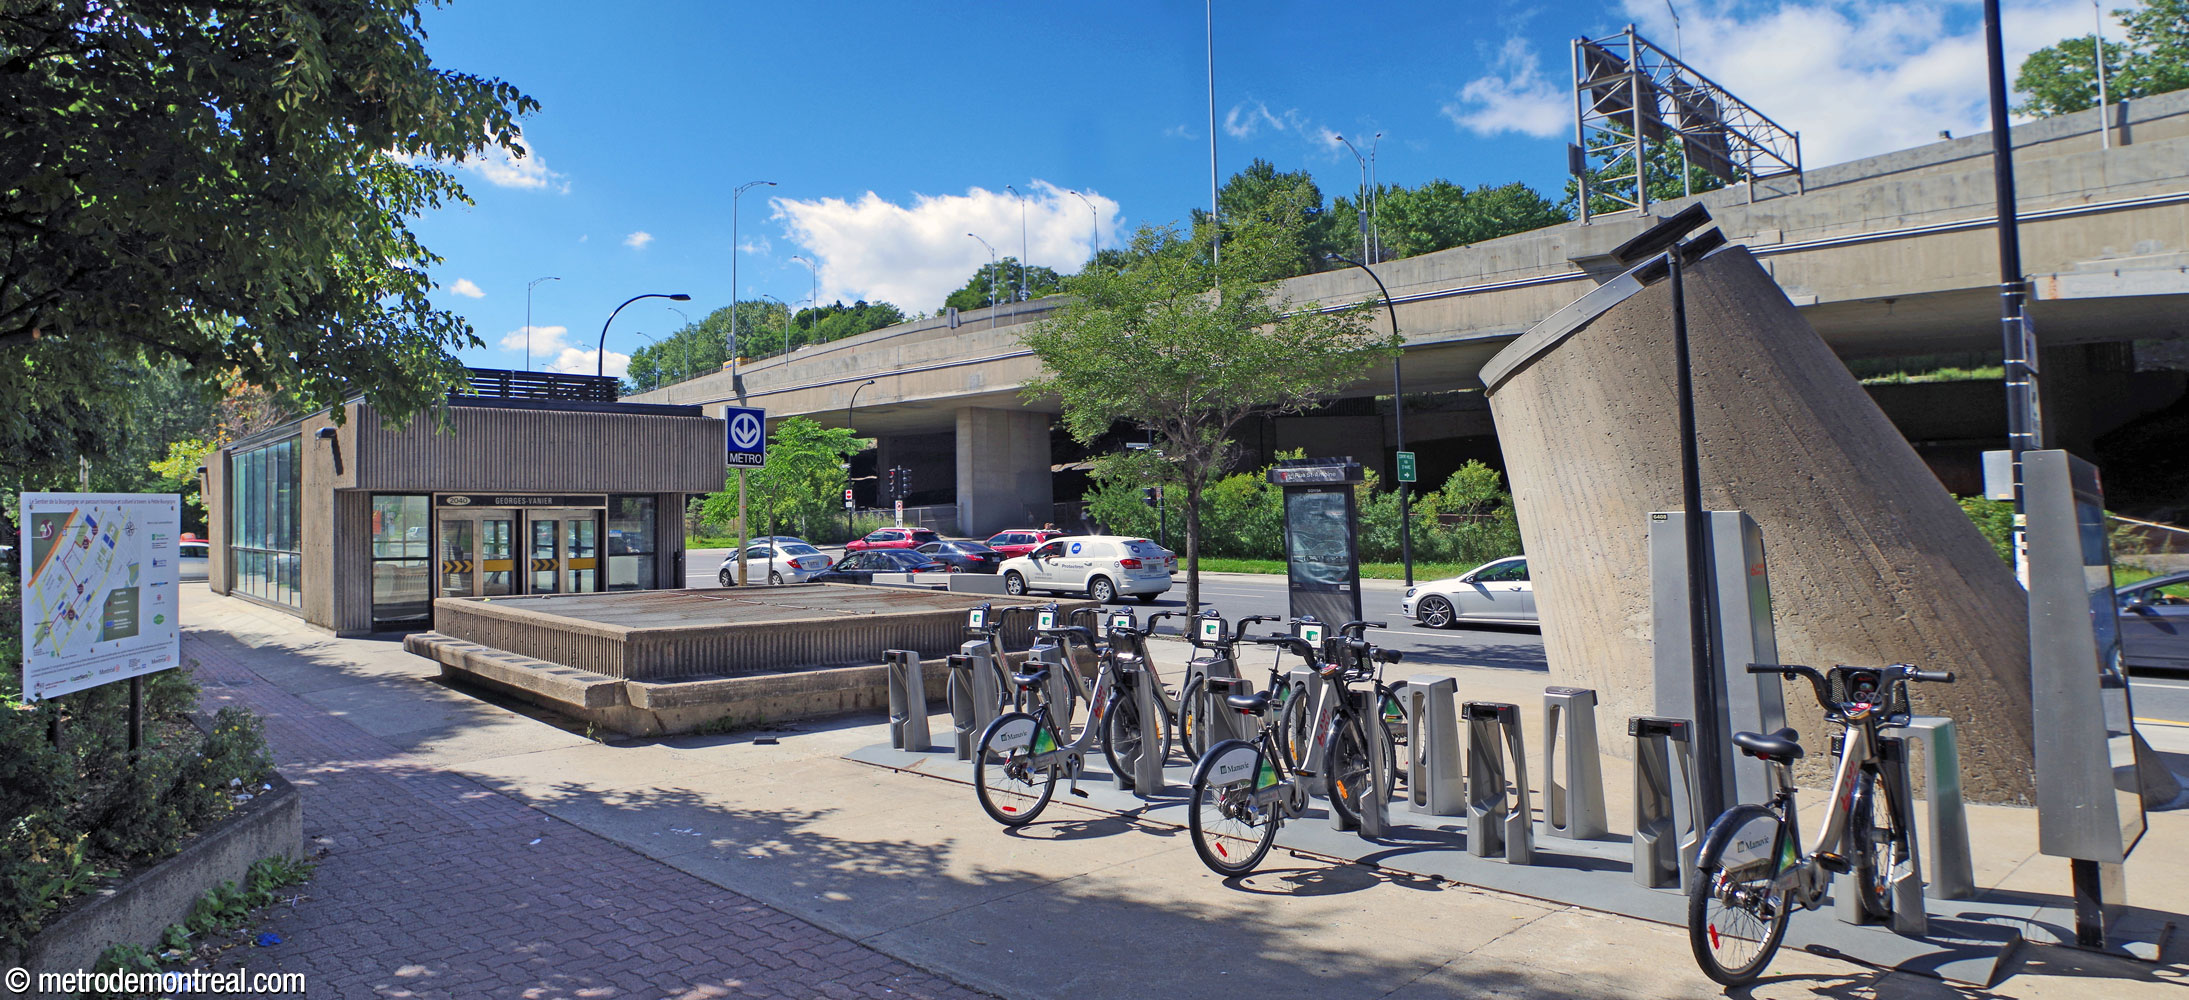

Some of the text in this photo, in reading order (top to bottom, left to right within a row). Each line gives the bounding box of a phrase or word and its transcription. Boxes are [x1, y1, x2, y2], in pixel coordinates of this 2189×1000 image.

[495, 497, 553, 505] GEORGES-VANIER
[1007, 731, 1028, 741] Manuvie
[1227, 761, 1249, 773] Manuvie
